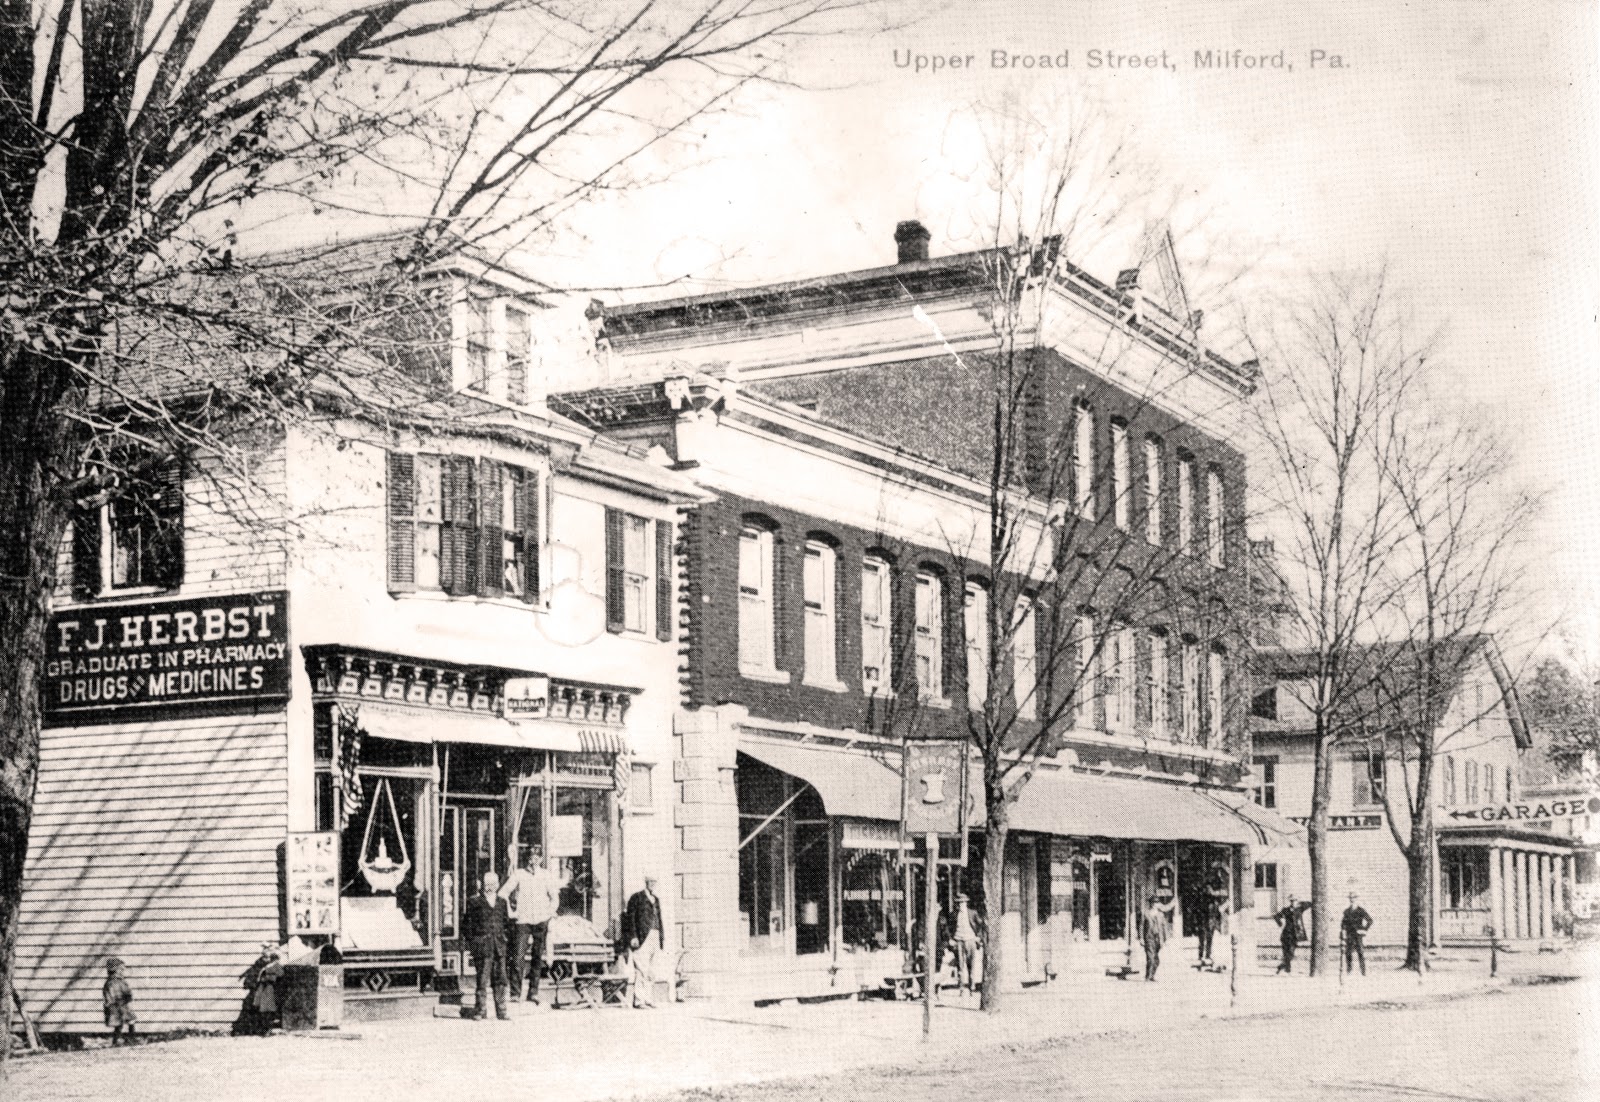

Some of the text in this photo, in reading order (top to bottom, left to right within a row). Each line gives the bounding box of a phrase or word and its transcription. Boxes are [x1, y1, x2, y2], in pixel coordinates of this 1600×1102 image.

[119, 604, 276, 649] HERBST
[47, 642, 287, 677] GRADUATE IN PHARMACY
[60, 675, 129, 703] DRUGS
[149, 665, 265, 697] MEDICINES
[1481, 799, 1586, 821] GARAGE
